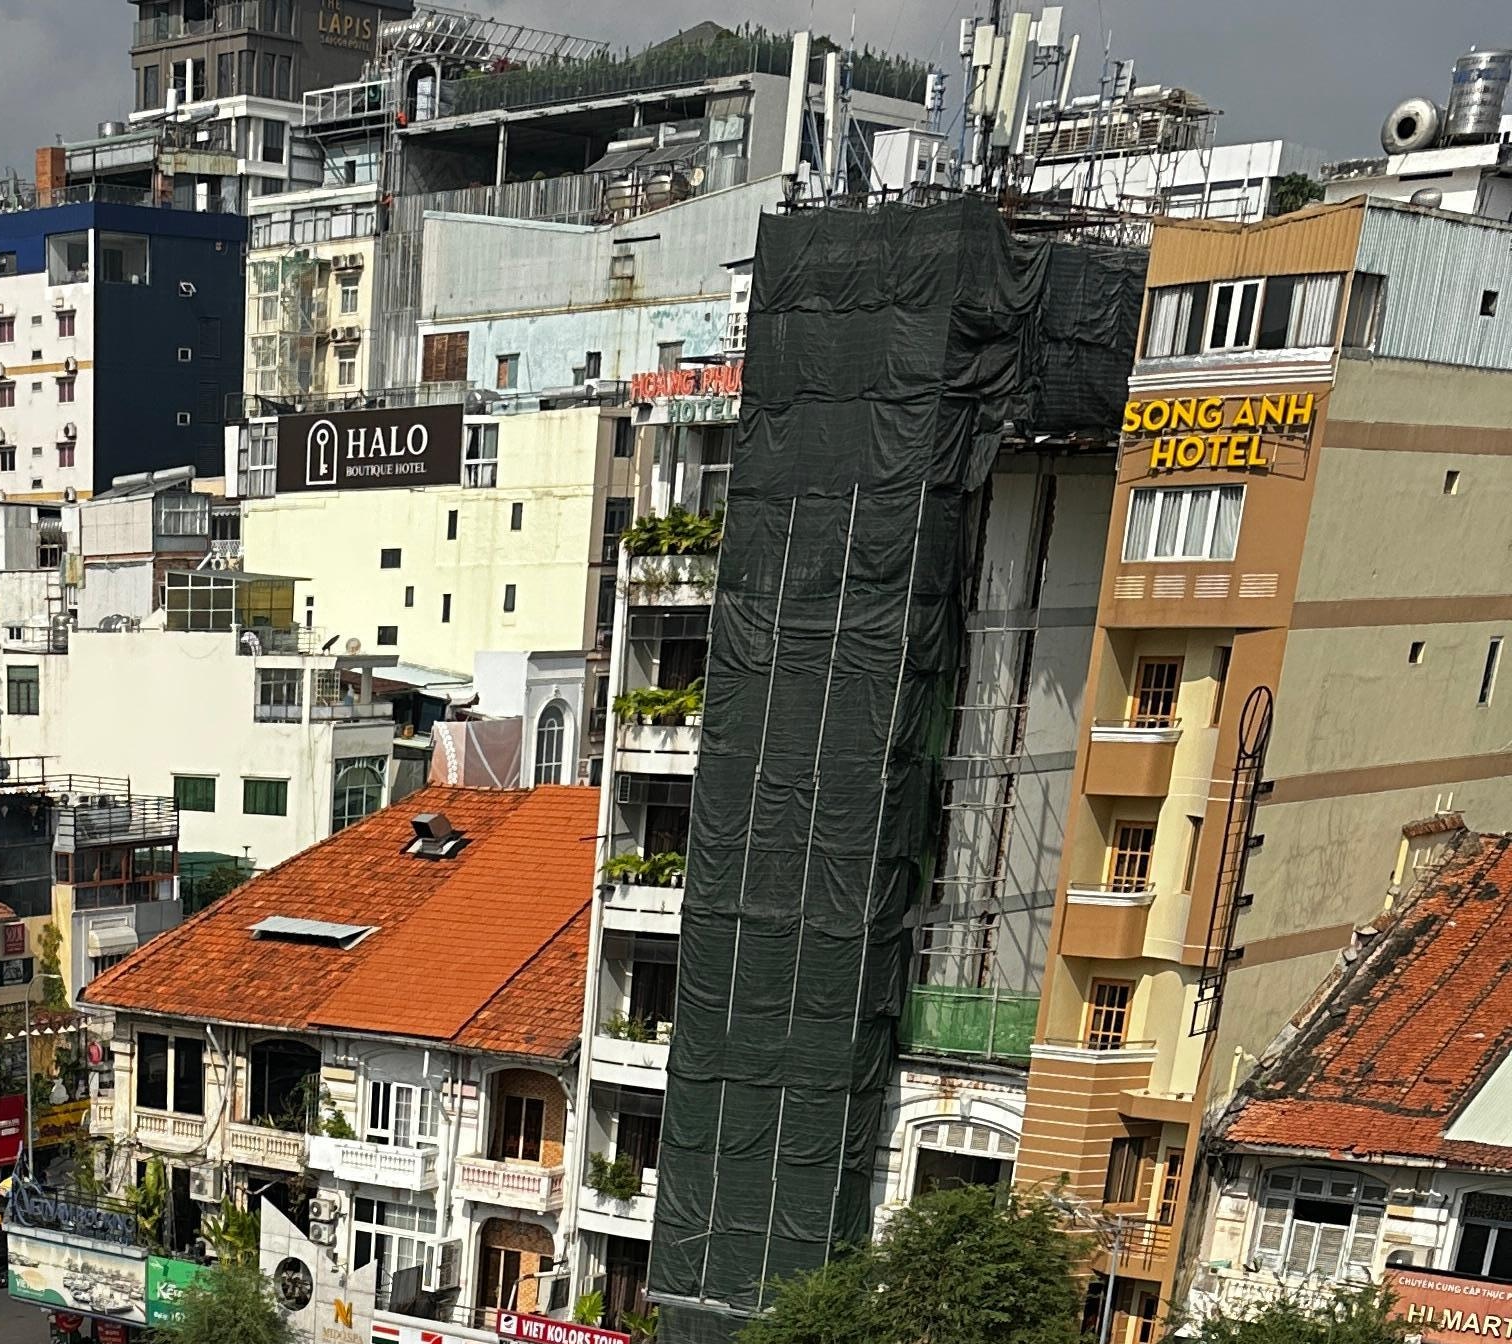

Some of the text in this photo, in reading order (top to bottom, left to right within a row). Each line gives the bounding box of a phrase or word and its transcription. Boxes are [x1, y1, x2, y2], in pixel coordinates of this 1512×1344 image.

[318, 10, 371, 40] LAPIS
[668, 397, 737, 423] HOTEL
[1122, 393, 1315, 433] SONG ANH
[346, 424, 428, 459] HALO
[1150, 434, 1267, 469] HOTEL
[346, 462, 427, 478] BOUTIQUE HOTEL
[1435, 1281, 1463, 1295] CUNG
[521, 1319, 546, 1341] VIET
